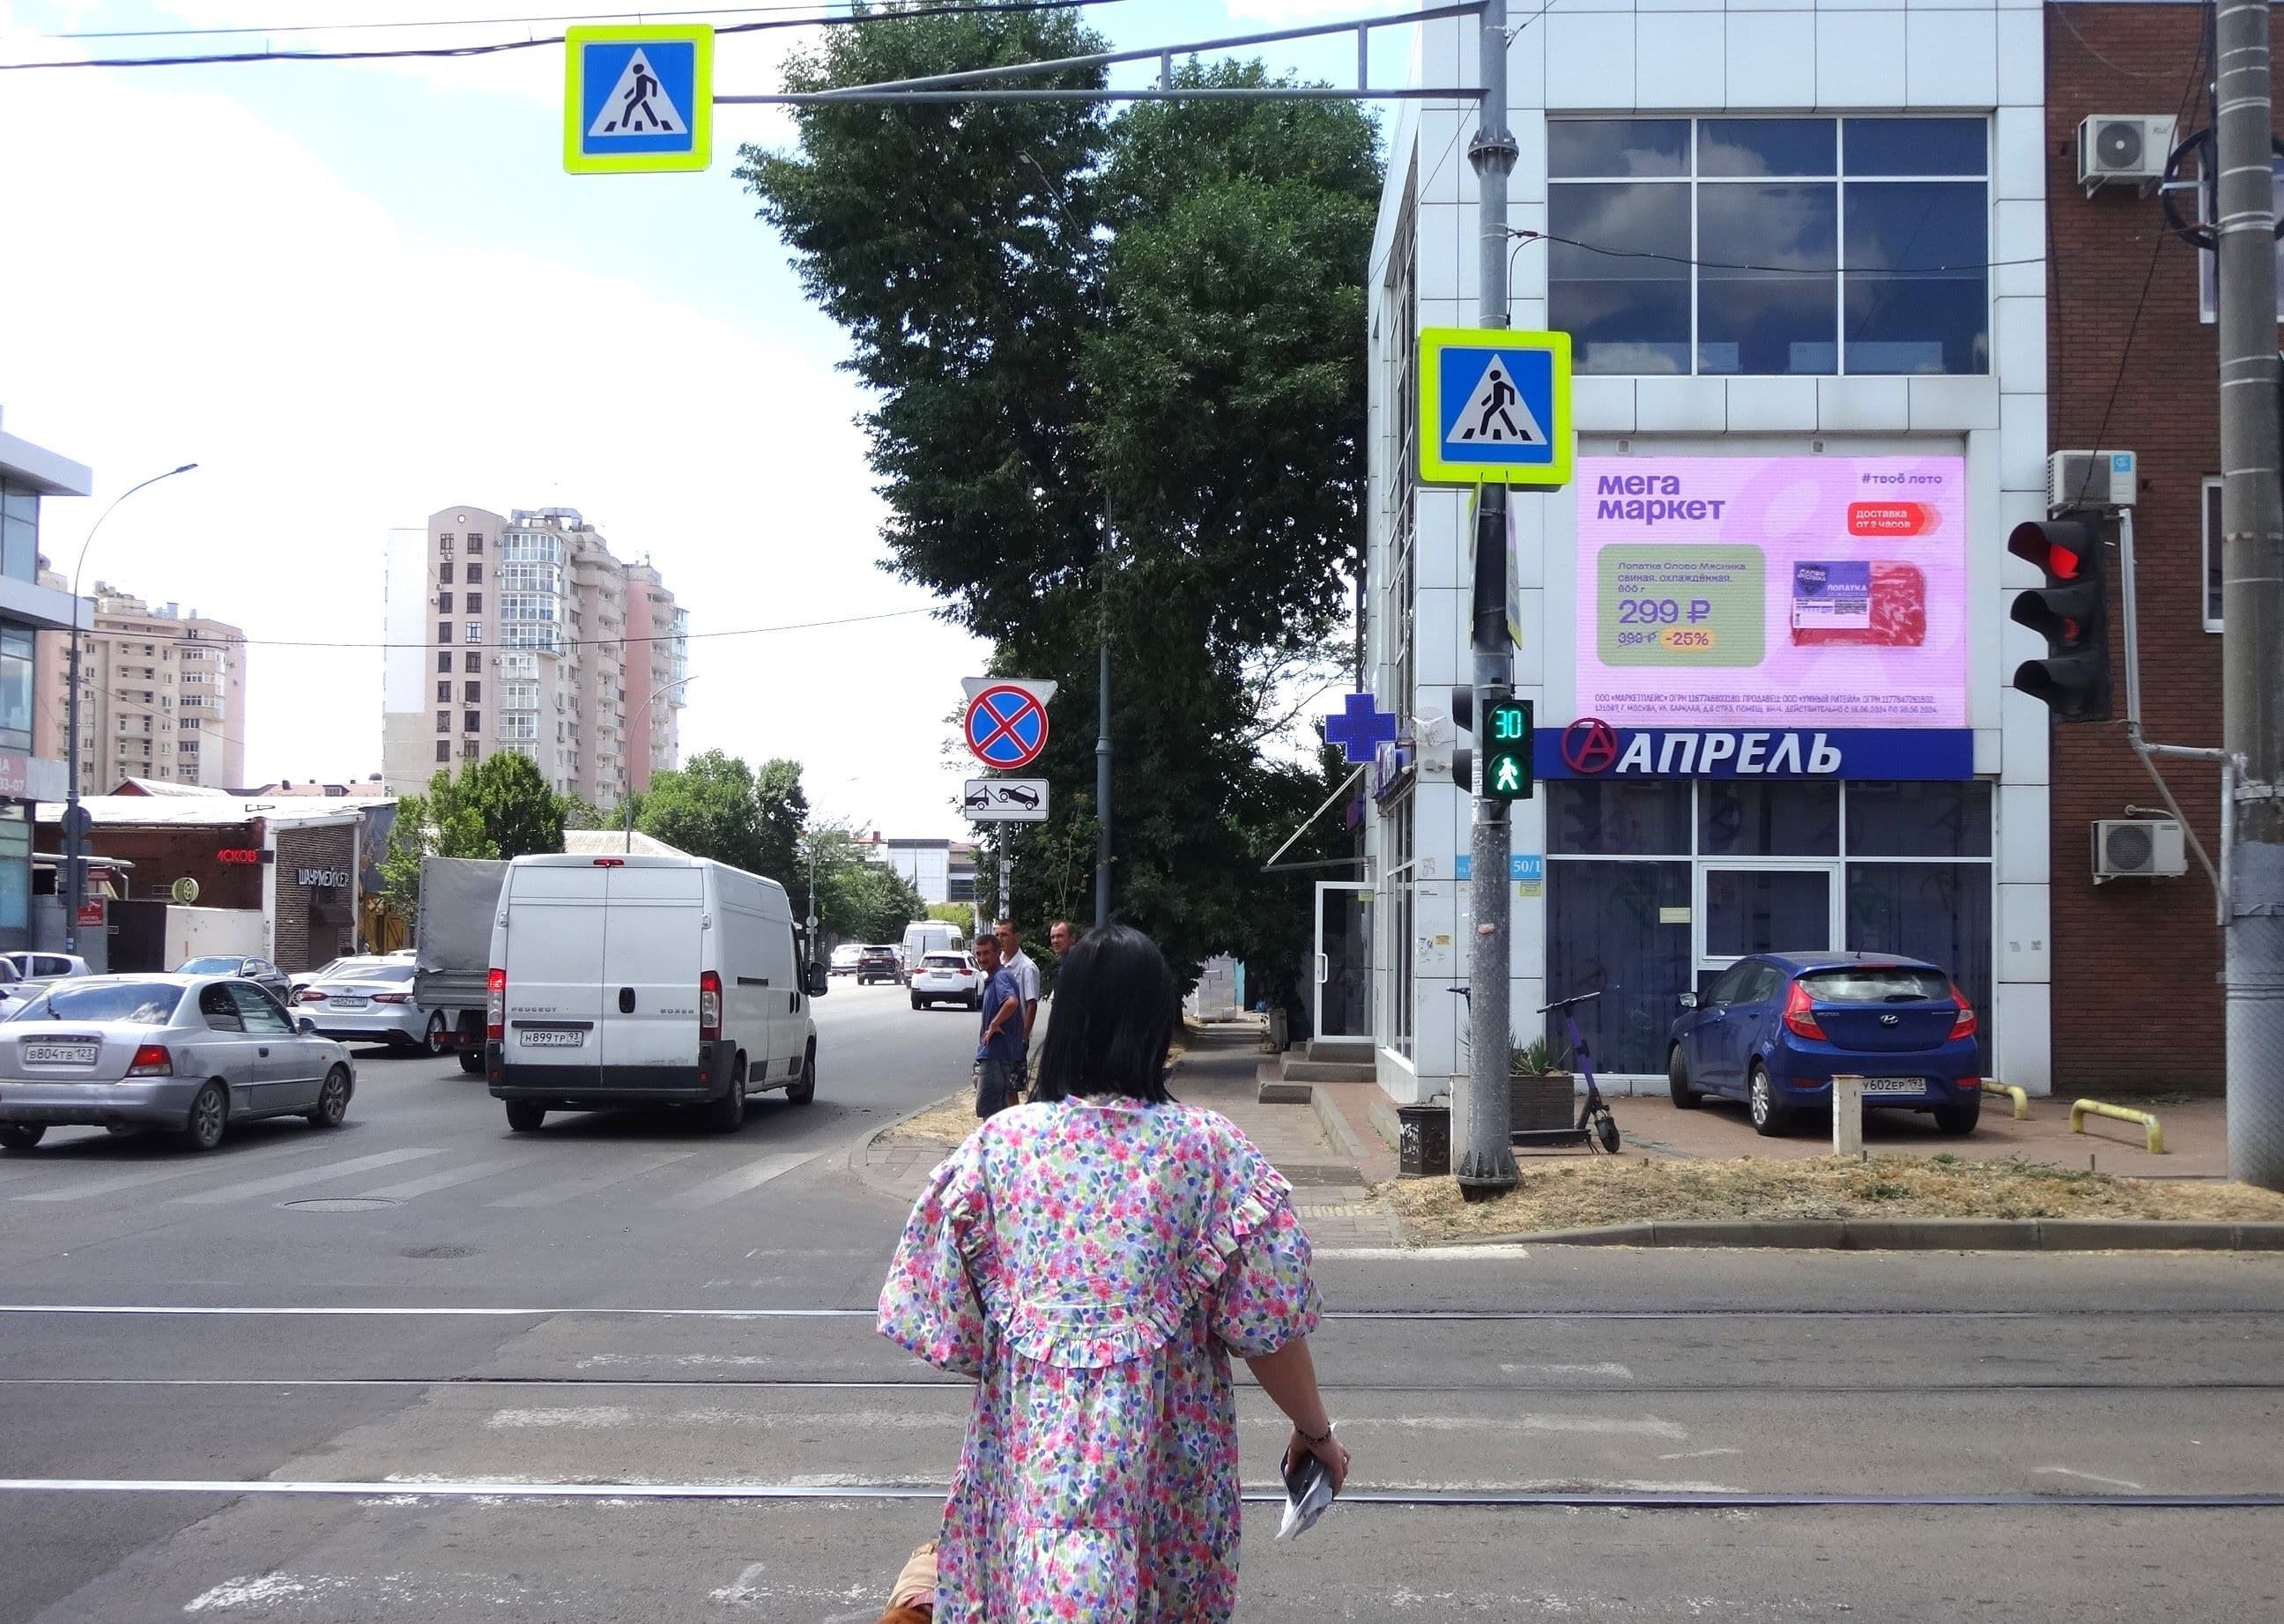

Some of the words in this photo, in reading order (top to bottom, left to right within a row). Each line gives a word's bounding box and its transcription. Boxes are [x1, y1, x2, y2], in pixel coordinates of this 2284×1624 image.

[1597, 475, 1680, 495] мега
[1597, 500, 1725, 525] маркет
[1618, 584, 1638, 593] 800
[1618, 598, 1680, 624] 299
[1687, 599, 1711, 624] ₽
[1665, 632, 1709, 646] -25%
[1594, 693, 1610, 702] ООО
[1785, 704, 1843, 713] ДЕЙСТВИТЕЛЬНО
[1496, 710, 1522, 738] 30
[1615, 733, 1843, 774] АПРЕЛЬ
[1514, 860, 1541, 872] 50/1
[298, 867, 350, 887] ШАУРМЕЙКЕР
